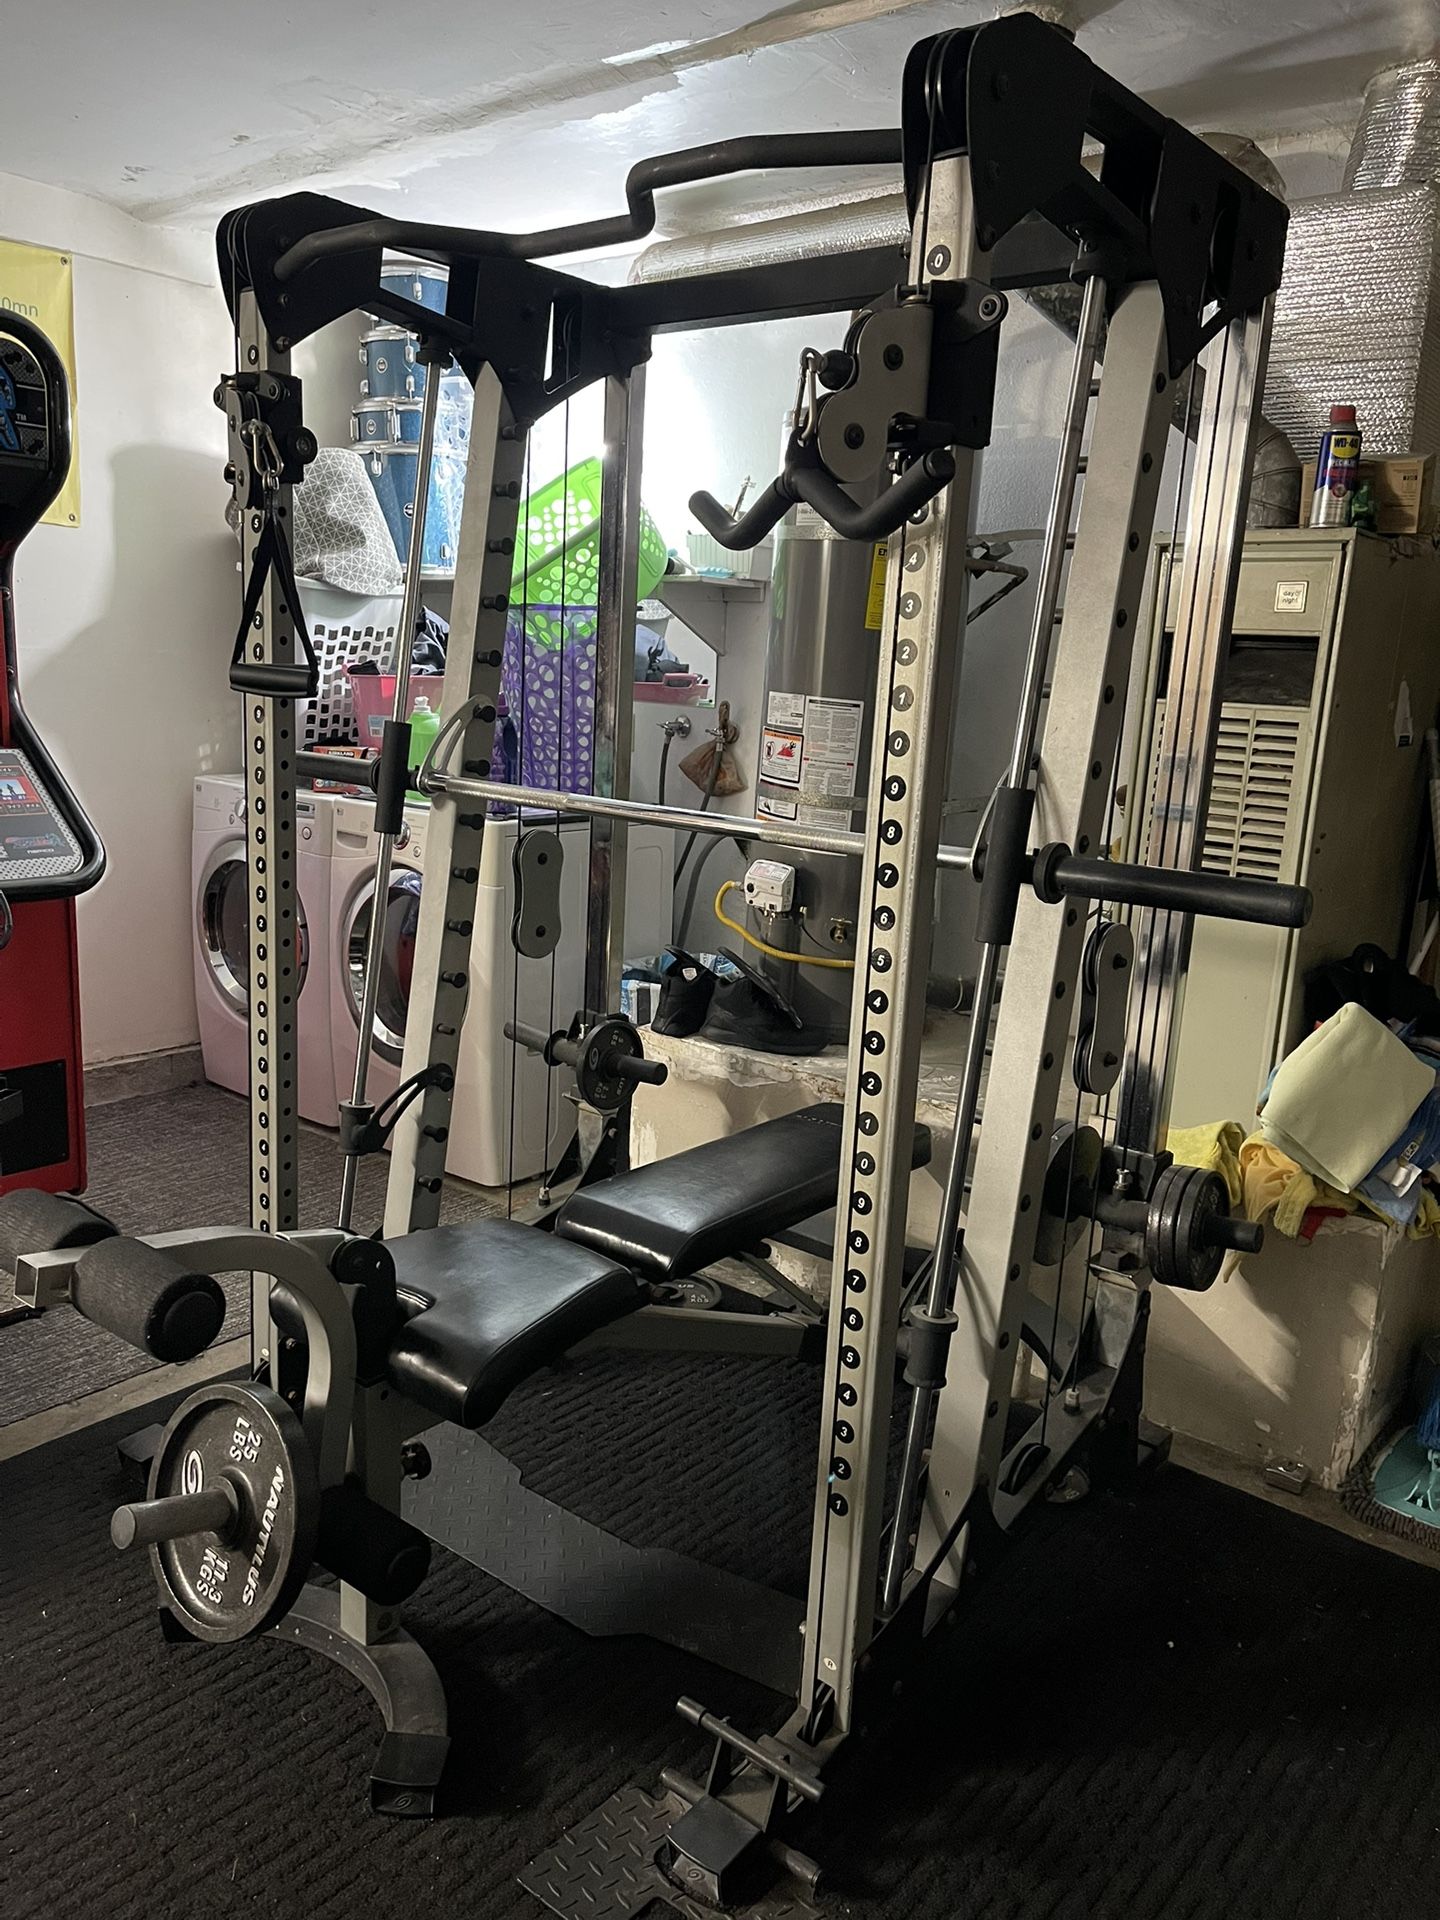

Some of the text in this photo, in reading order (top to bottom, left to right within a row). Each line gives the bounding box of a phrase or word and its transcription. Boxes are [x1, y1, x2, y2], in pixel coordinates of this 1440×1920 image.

[934, 253, 944, 268] 0
[1334, 437, 1359, 448] WD-40
[908, 551, 918, 566] 4
[905, 599, 914, 613] 3
[901, 645, 911, 660] 2
[898, 691, 906, 705] 1
[894, 737, 903, 751] 0
[890, 781, 899, 795] 9
[886, 826, 896, 839] 8
[884, 869, 893, 882] 7
[880, 912, 889, 925] 6
[876, 954, 885, 967] 5
[872, 996, 882, 1008] 4
[869, 1037, 879, 1049] 3
[867, 1077, 875, 1090] 2
[864, 1118, 871, 1130] 1
[860, 1158, 869, 1170] 0
[857, 1197, 866, 1209] 9
[854, 1236, 863, 1248] 8
[852, 1275, 860, 1286] 7
[849, 1313, 857, 1325] 6
[846, 1351, 854, 1363] 5
[843, 1390, 851, 1400] 4
[840, 1426, 848, 1437] 3
[230, 1416, 250, 1462] LBS
[243, 1430, 261, 1463] 25
[837, 1463, 845, 1474] 2
[836, 1500, 842, 1510] 1
[242, 1465, 285, 1606] NAUTILUS
[196, 1548, 218, 1597] KGS
[208, 1559, 229, 1604] 11.3
